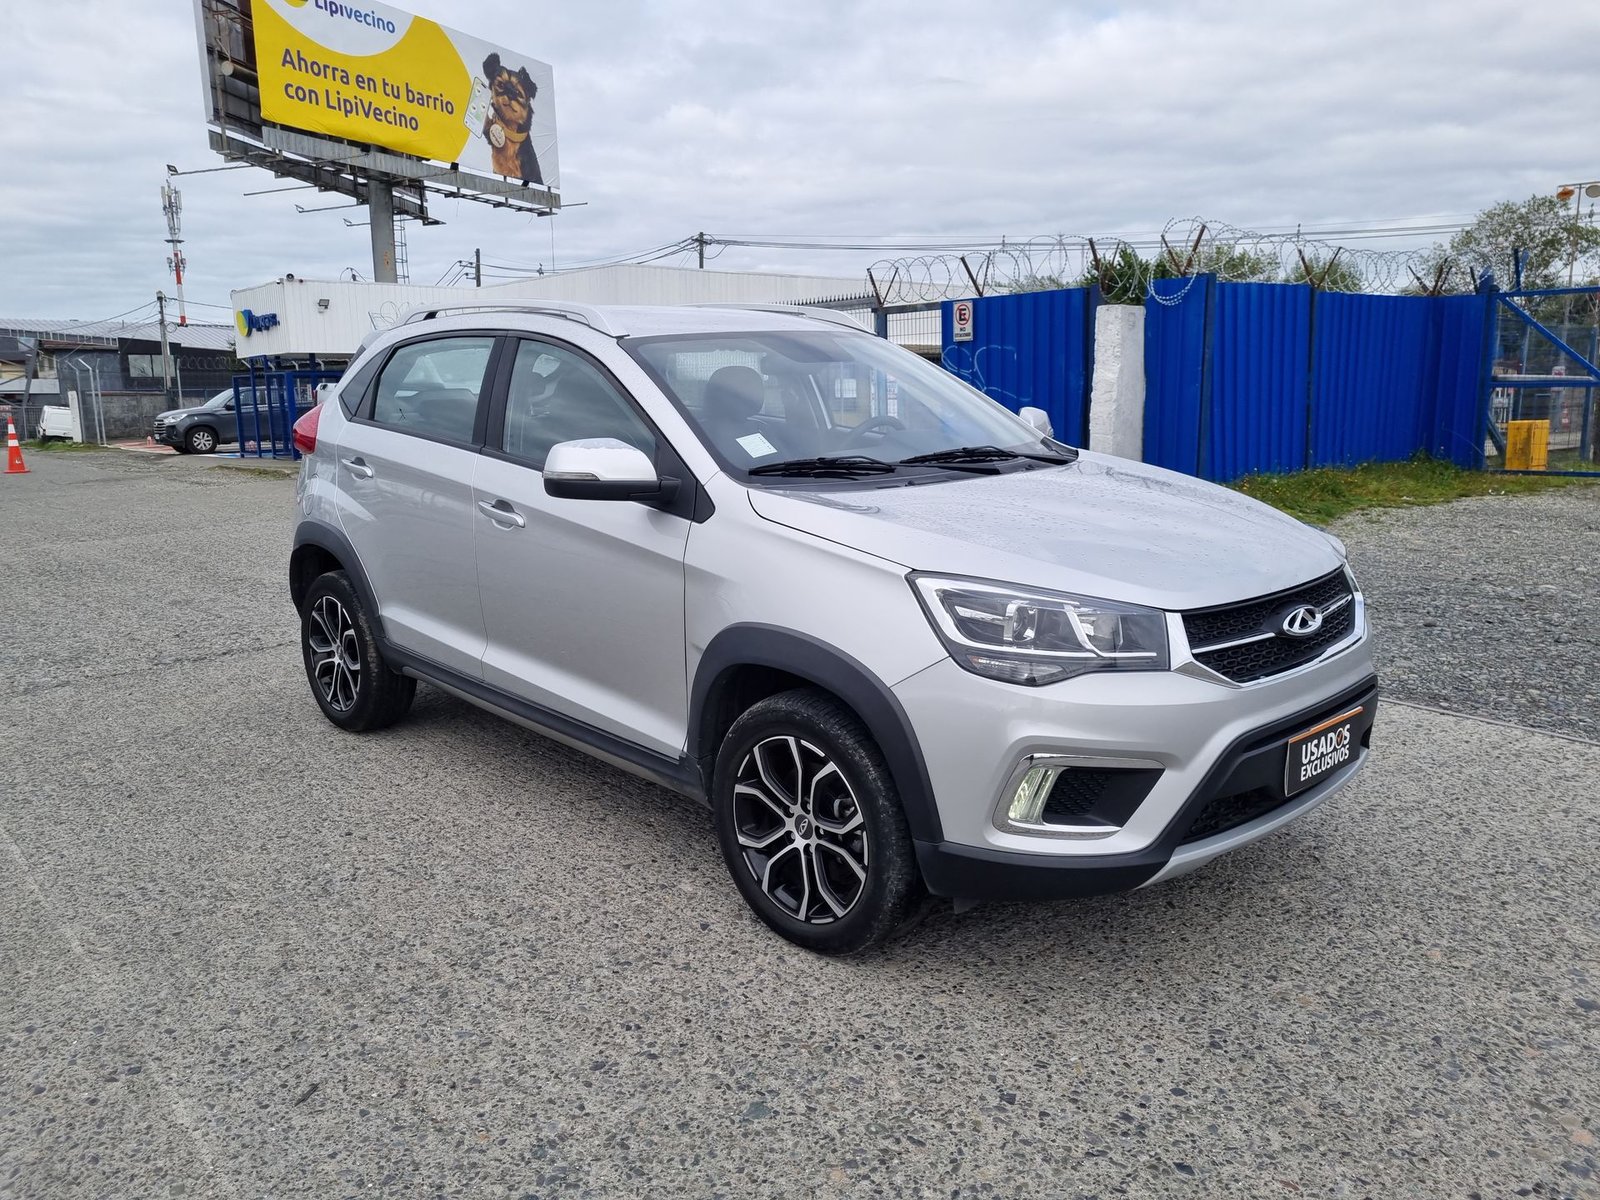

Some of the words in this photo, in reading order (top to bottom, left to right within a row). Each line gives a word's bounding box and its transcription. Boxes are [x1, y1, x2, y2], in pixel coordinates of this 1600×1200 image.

[281, 48, 350, 85] Ahorra
[355, 73, 378, 93] en
[382, 77, 401, 99] tu
[405, 82, 455, 115] barrio
[284, 83, 320, 106] con
[325, 89, 419, 131] LipiVecino
[1300, 744, 1350, 782] EXCLUSIVOS
[1301, 723, 1351, 764] USADOS
